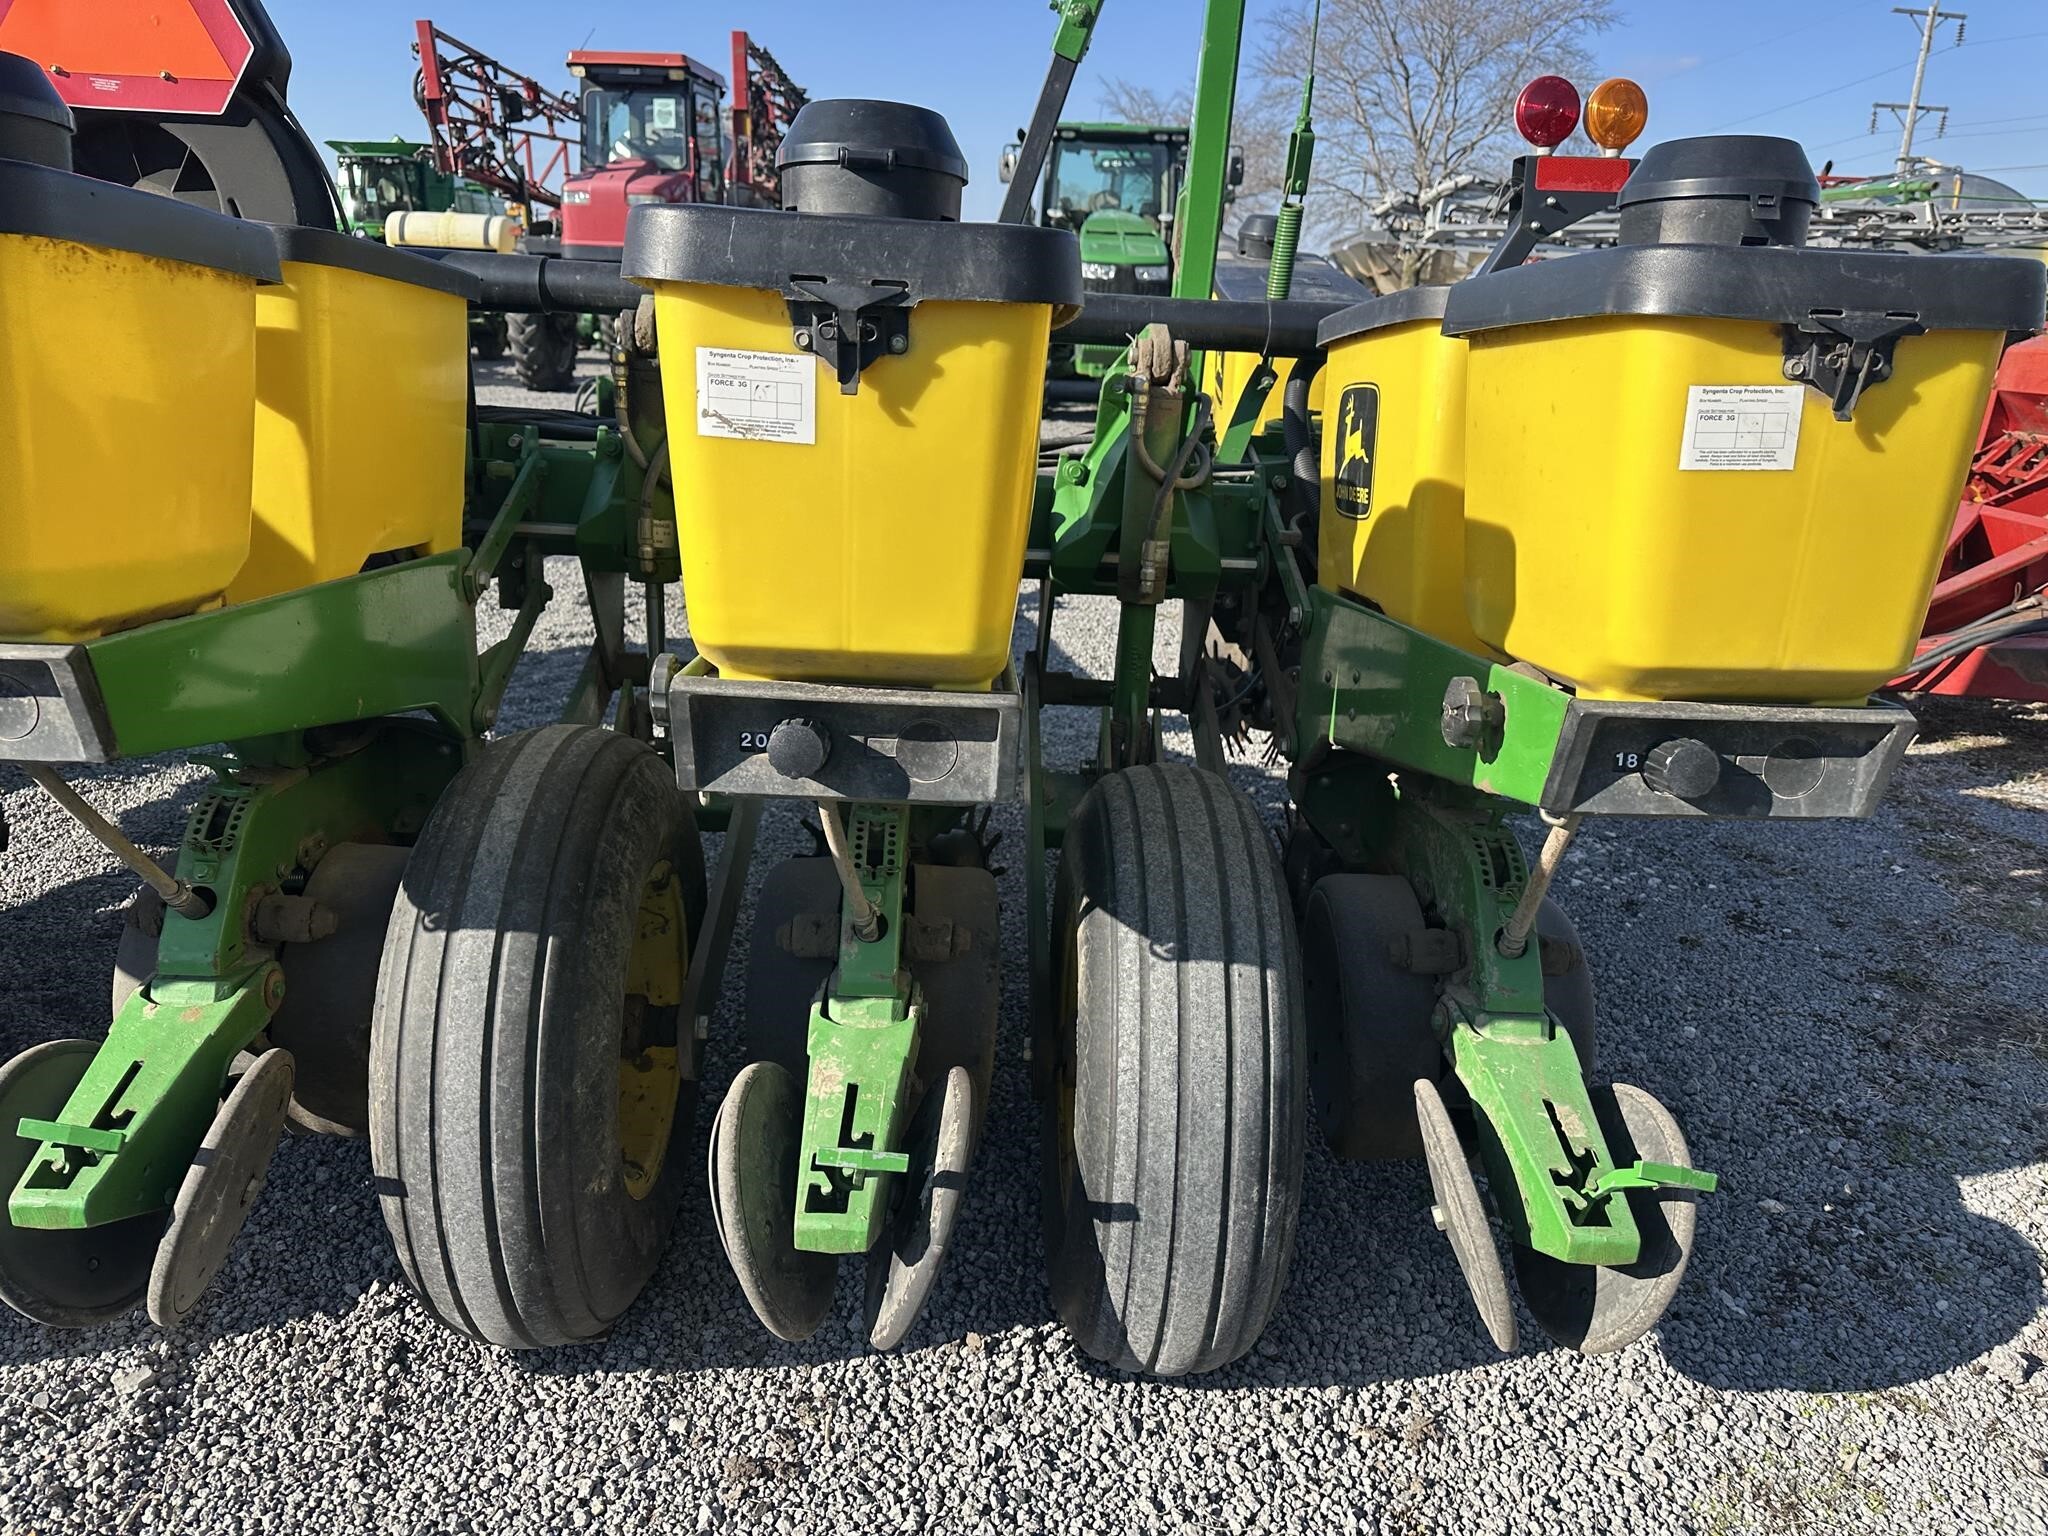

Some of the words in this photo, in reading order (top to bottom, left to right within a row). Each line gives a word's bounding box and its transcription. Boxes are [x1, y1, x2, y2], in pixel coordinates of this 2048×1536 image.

[709, 351, 736, 360] Syngenta
[737, 353, 752, 361] Crop
[753, 354, 784, 363] Protection,
[710, 379, 735, 387] FORCE
[1336, 484, 1348, 500] JOHN
[1349, 486, 1369, 504] DEERE
[741, 732, 768, 748] 20
[1615, 751, 1638, 768] 18
